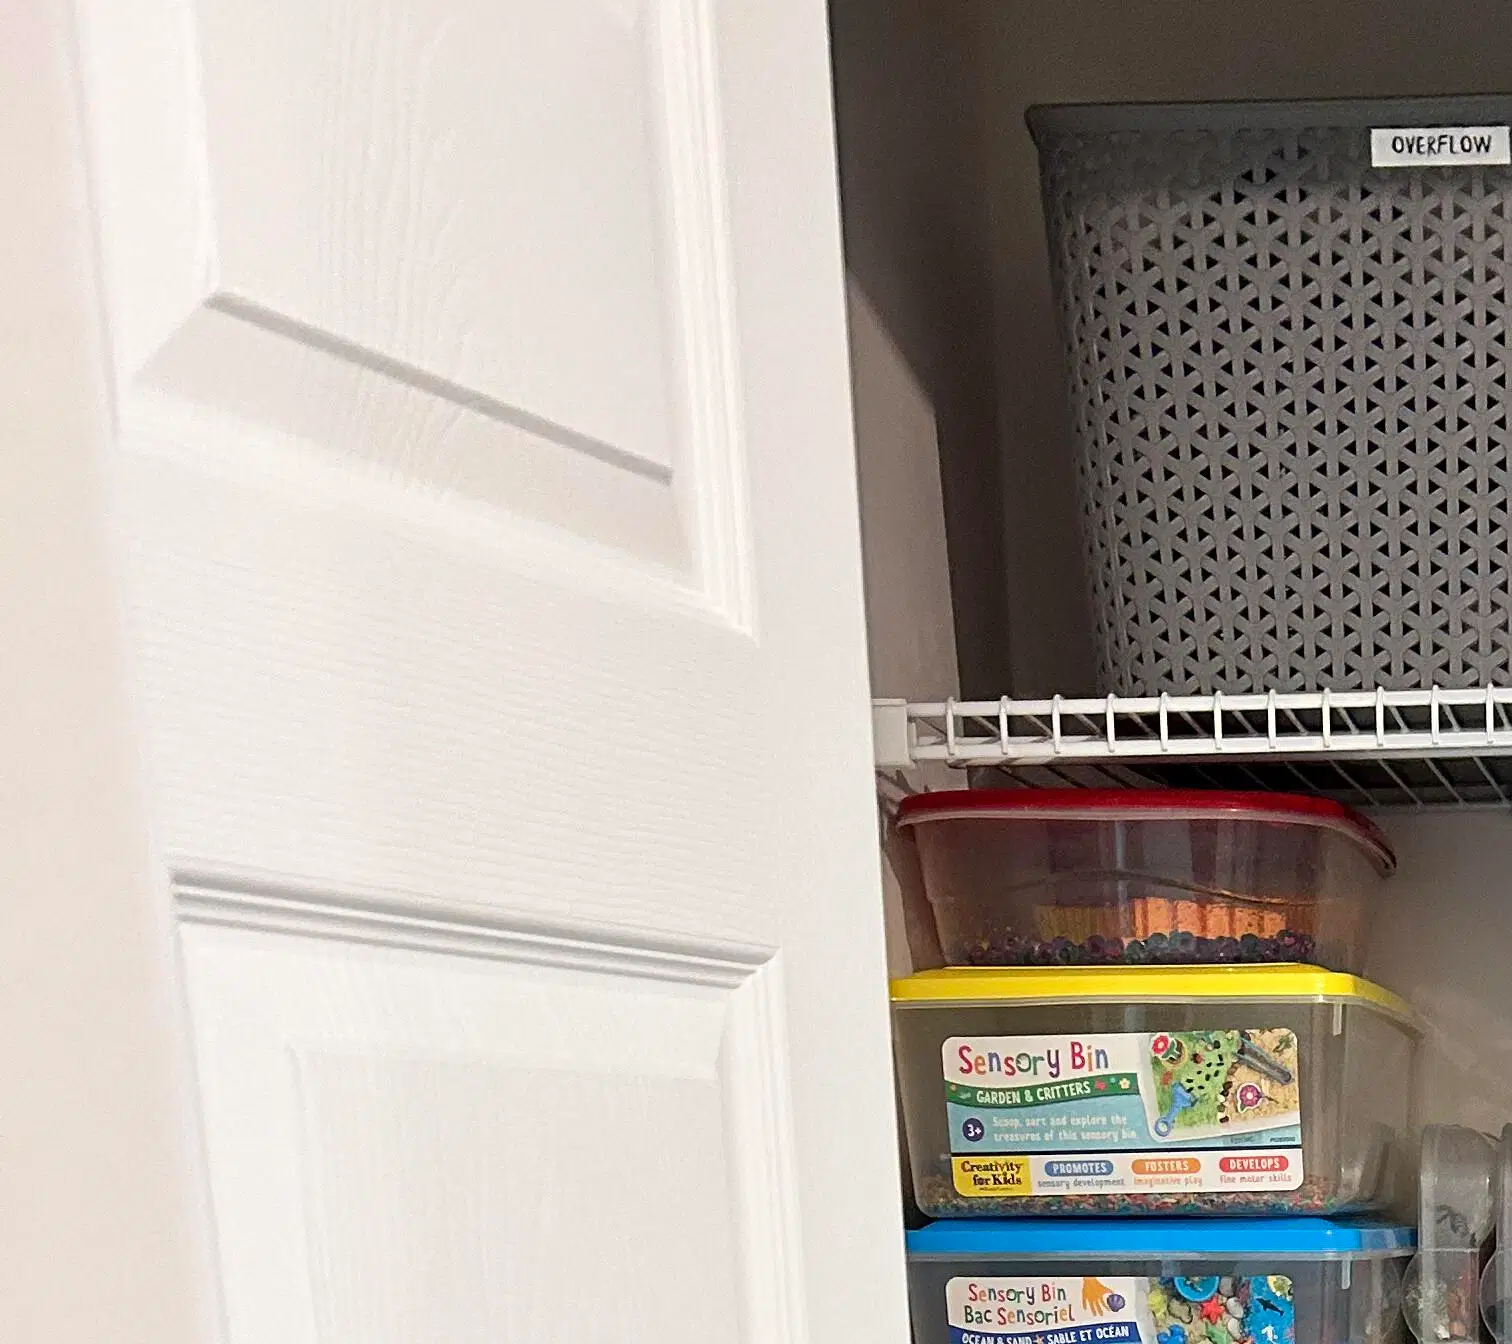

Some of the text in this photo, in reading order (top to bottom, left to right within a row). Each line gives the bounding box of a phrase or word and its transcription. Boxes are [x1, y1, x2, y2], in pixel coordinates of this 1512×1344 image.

[1392, 134, 1491, 157] OVERFLOW
[958, 1041, 1109, 1078] Sensory Bin
[976, 1081, 1091, 1104] GARDEN & CRITTERS
[1070, 1116, 1108, 1128] explore
[1111, 1115, 1127, 1125] the
[967, 1124, 982, 1137] 3+
[961, 1161, 1023, 1173] Creativity
[1053, 1164, 1107, 1174] PROMOTES
[1145, 1161, 1189, 1172] FOSTERS
[1230, 1158, 1280, 1170] DEVELOPS
[973, 1173, 1022, 1186] for Kids
[1037, 1177, 1125, 1188] sensory development
[1133, 1175, 1203, 1187] imaginative play
[1267, 1174, 1292, 1182] skills
[968, 1283, 1066, 1305] Sensory Bin
[964, 1304, 1075, 1325] Bac Sensoriel
[1080, 1330, 1092, 1341] ET
[1096, 1325, 1129, 1339] OCÉAN
